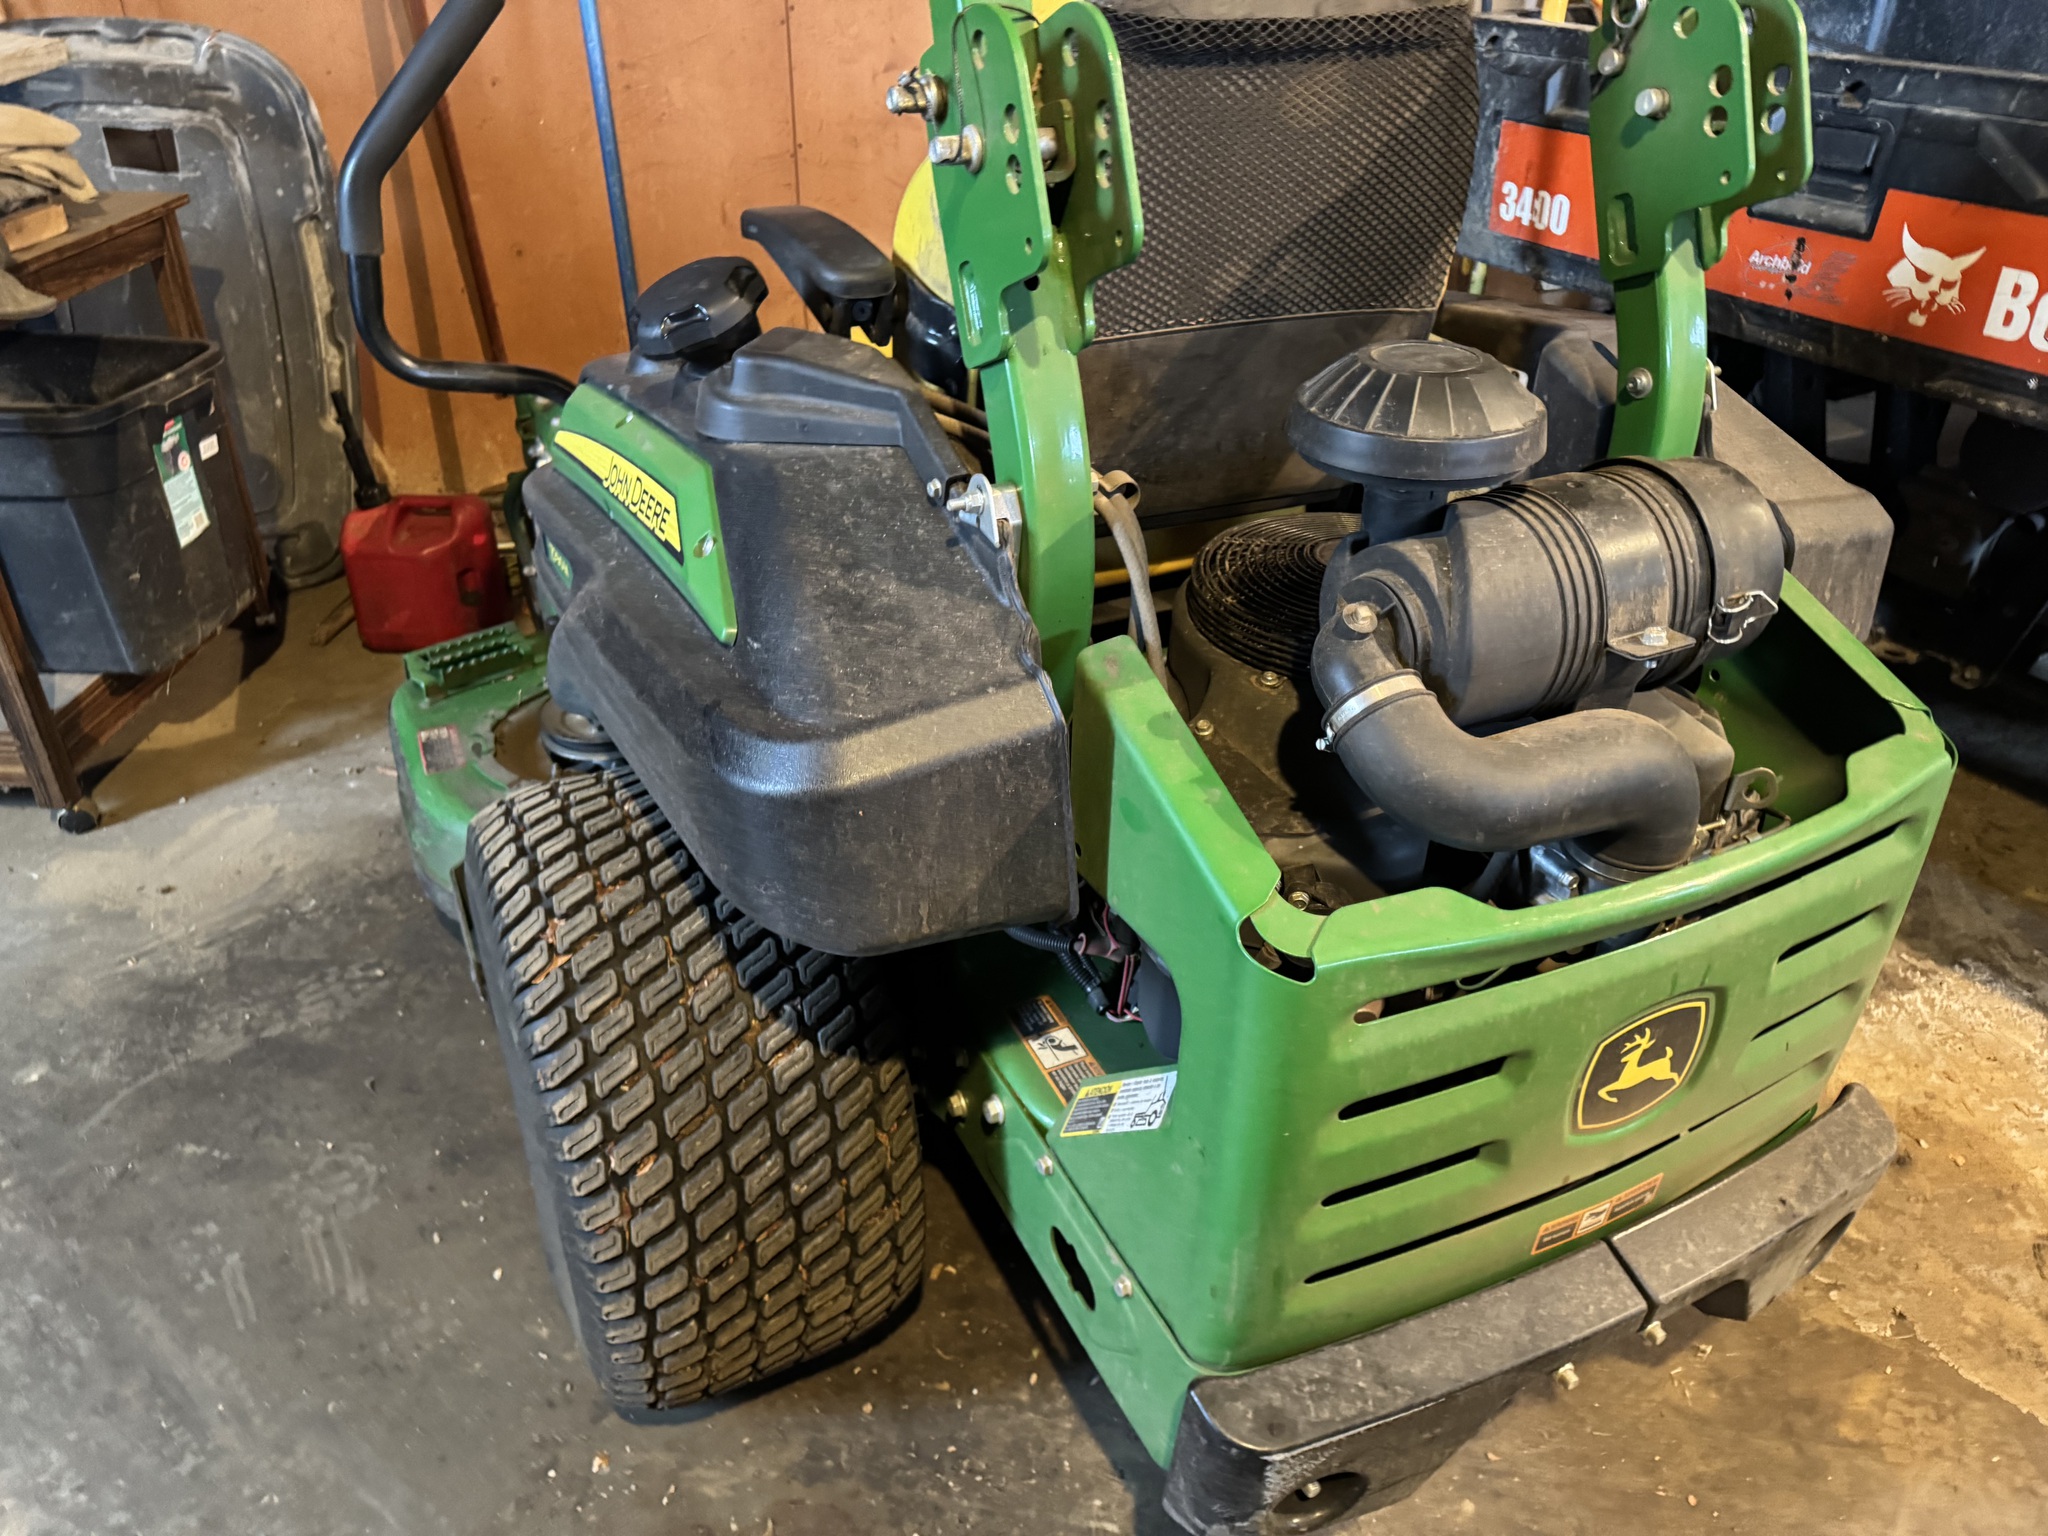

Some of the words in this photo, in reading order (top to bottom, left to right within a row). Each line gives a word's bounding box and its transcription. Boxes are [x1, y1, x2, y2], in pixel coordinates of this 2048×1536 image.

[1499, 181, 1571, 236] 3400
[1748, 249, 1812, 275] Archbd
[604, 456, 633, 499] JOHN
[631, 477, 670, 534] DEERE
